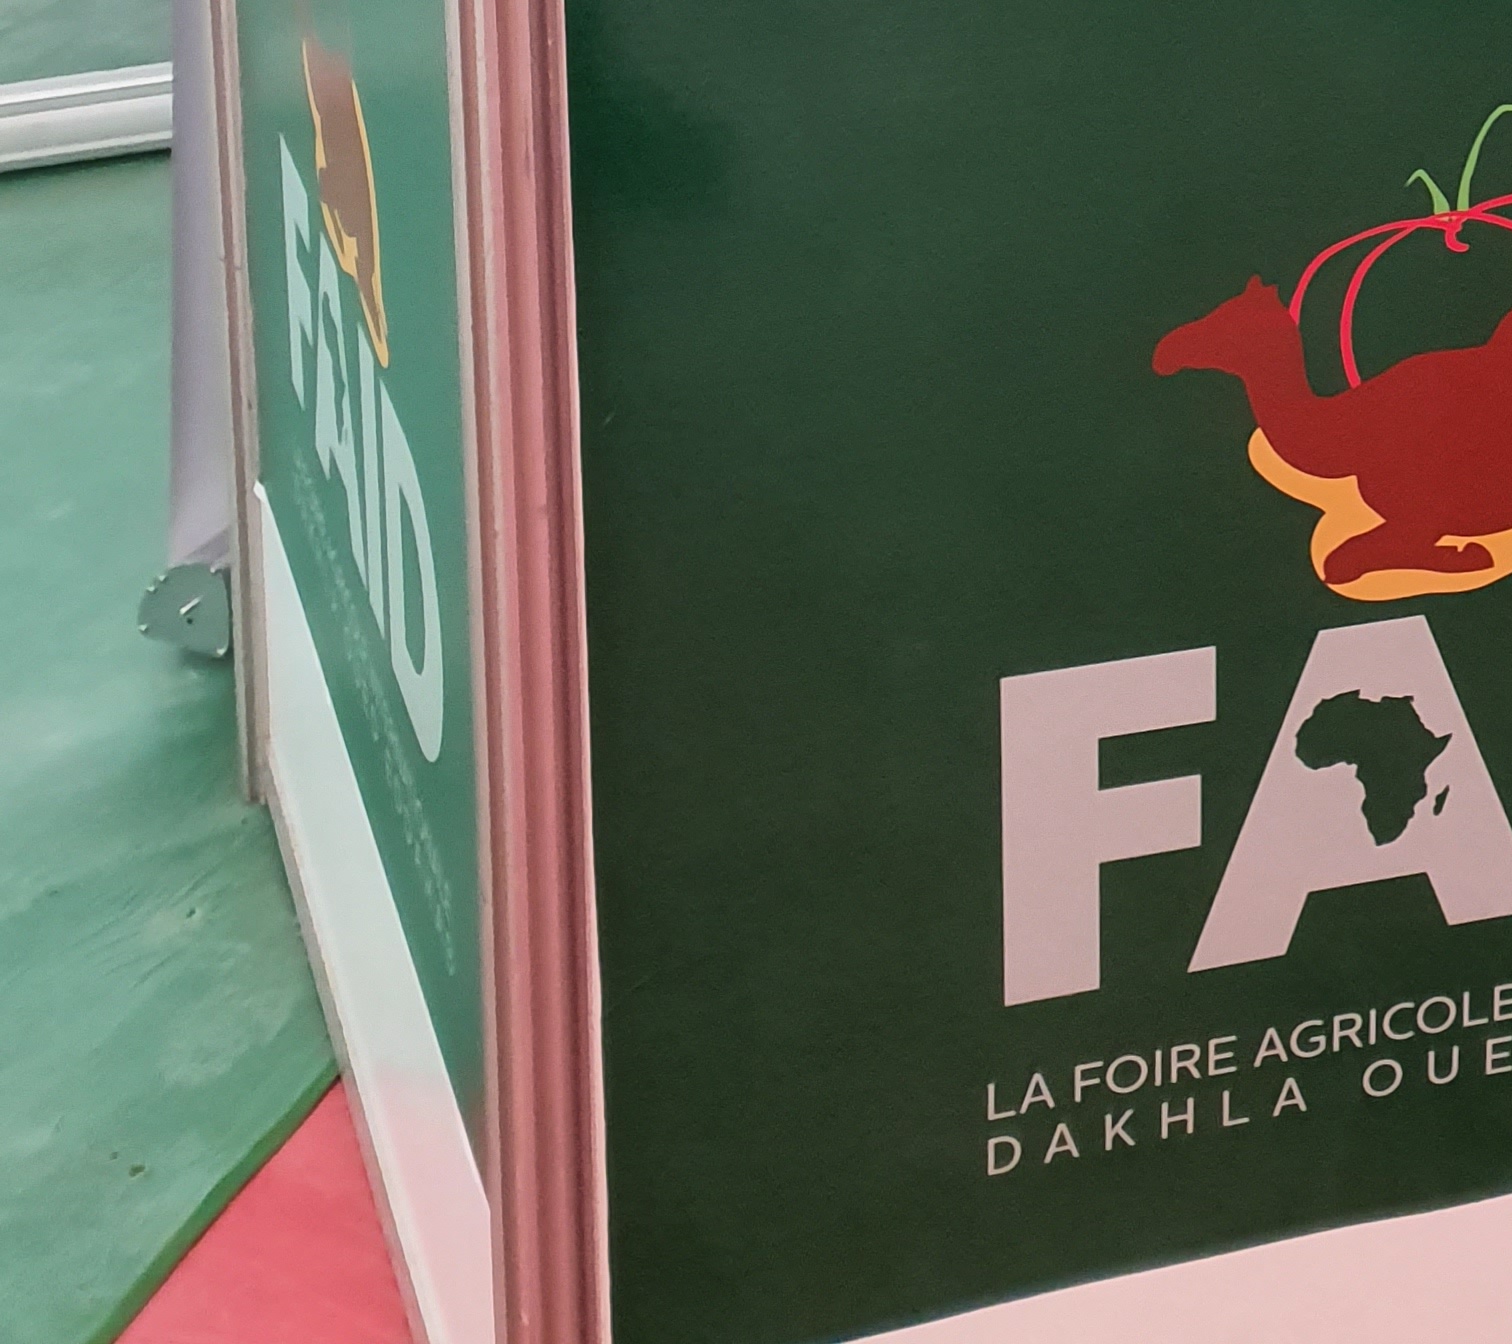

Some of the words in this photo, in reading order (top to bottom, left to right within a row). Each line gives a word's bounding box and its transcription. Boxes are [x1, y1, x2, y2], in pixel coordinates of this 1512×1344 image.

[281, 132, 443, 762] FAID
[987, 1072, 1055, 1121] LA
[1074, 1035, 1237, 1103] FOIRE
[987, 1077, 1307, 1176] DAKHLA
